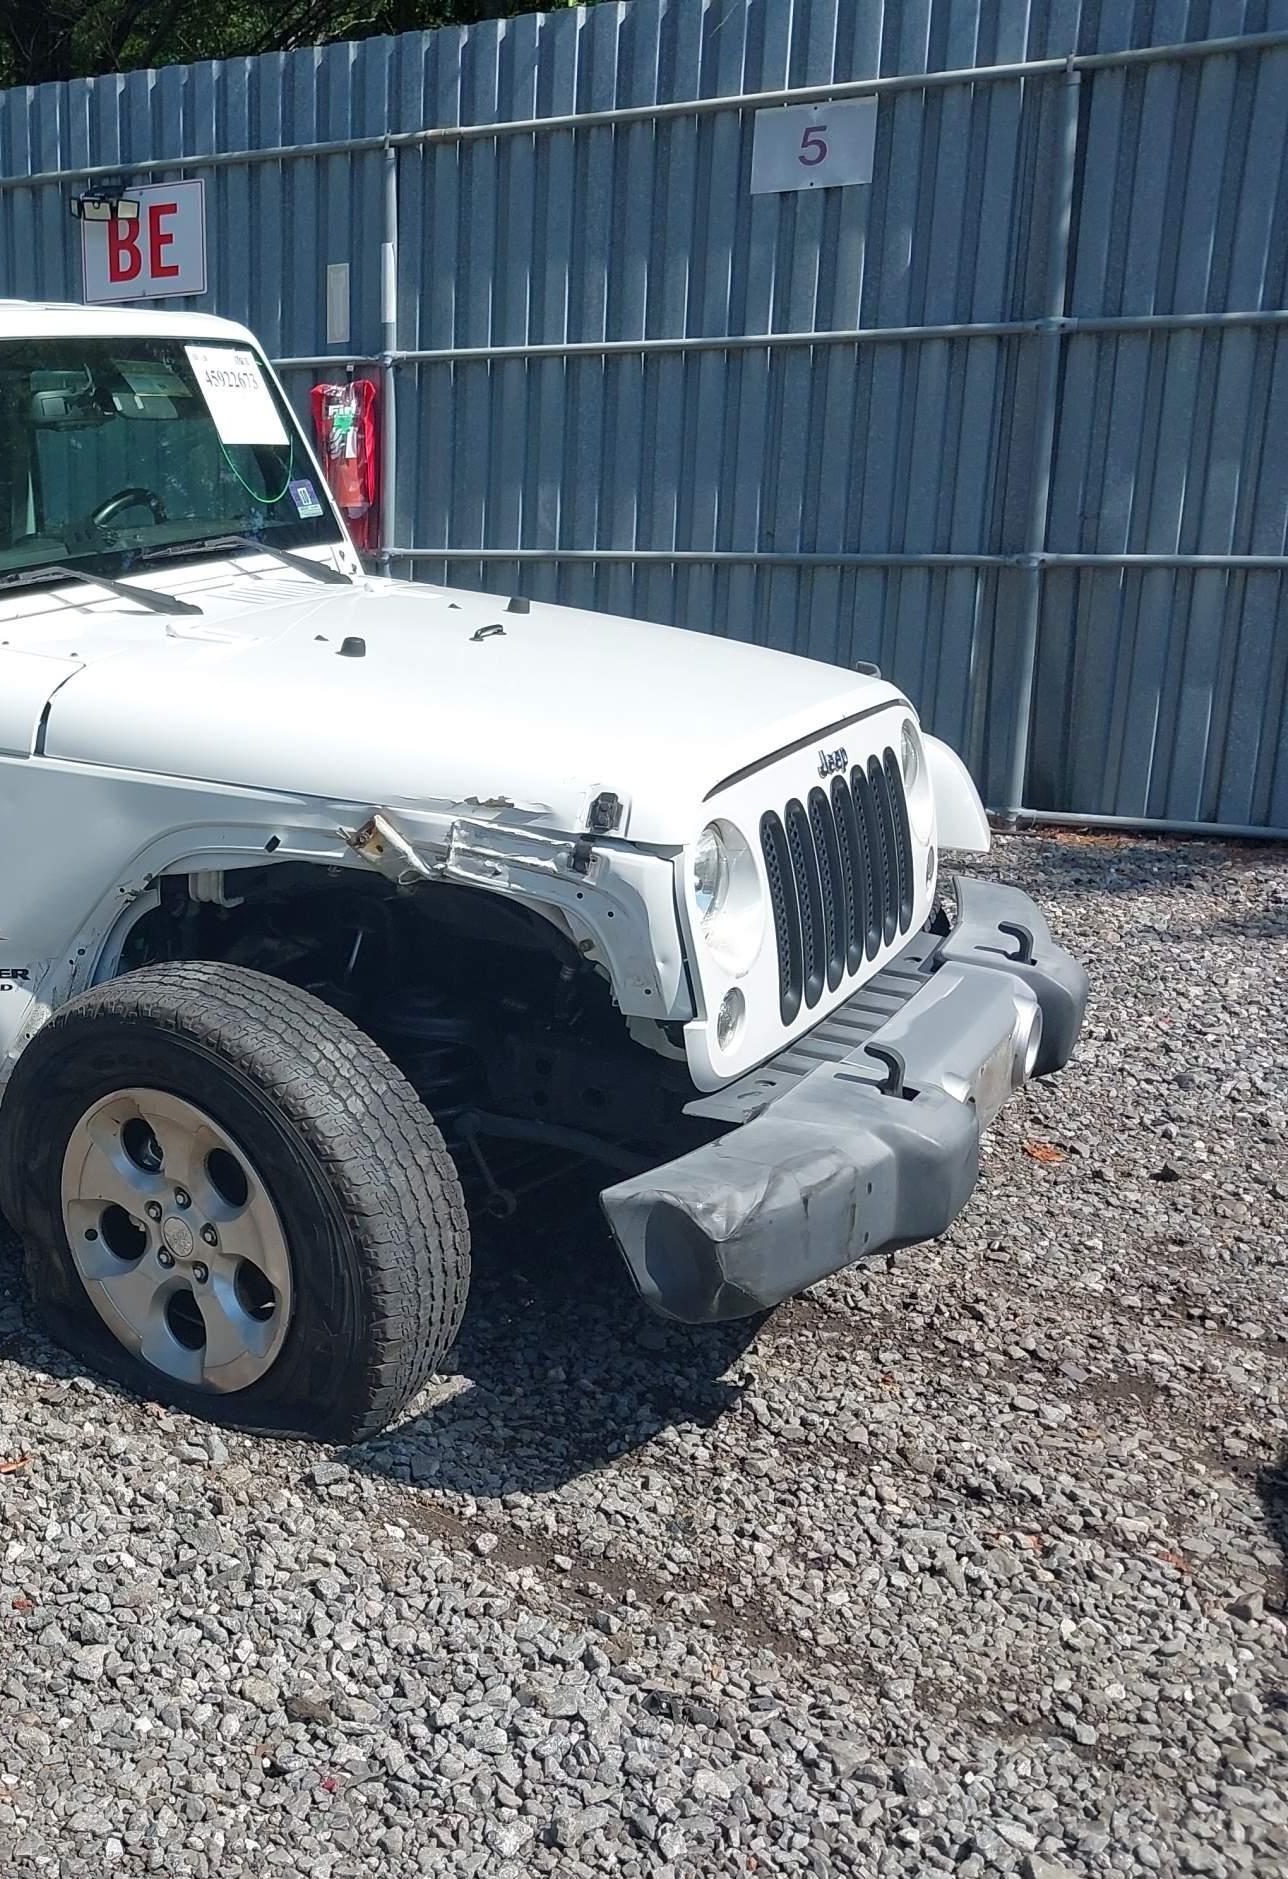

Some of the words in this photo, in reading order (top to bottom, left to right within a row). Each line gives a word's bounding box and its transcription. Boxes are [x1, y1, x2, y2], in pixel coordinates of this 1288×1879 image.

[798, 125, 828, 166] 5
[108, 203, 179, 283] BE
[817, 747, 848, 779] Jeep
